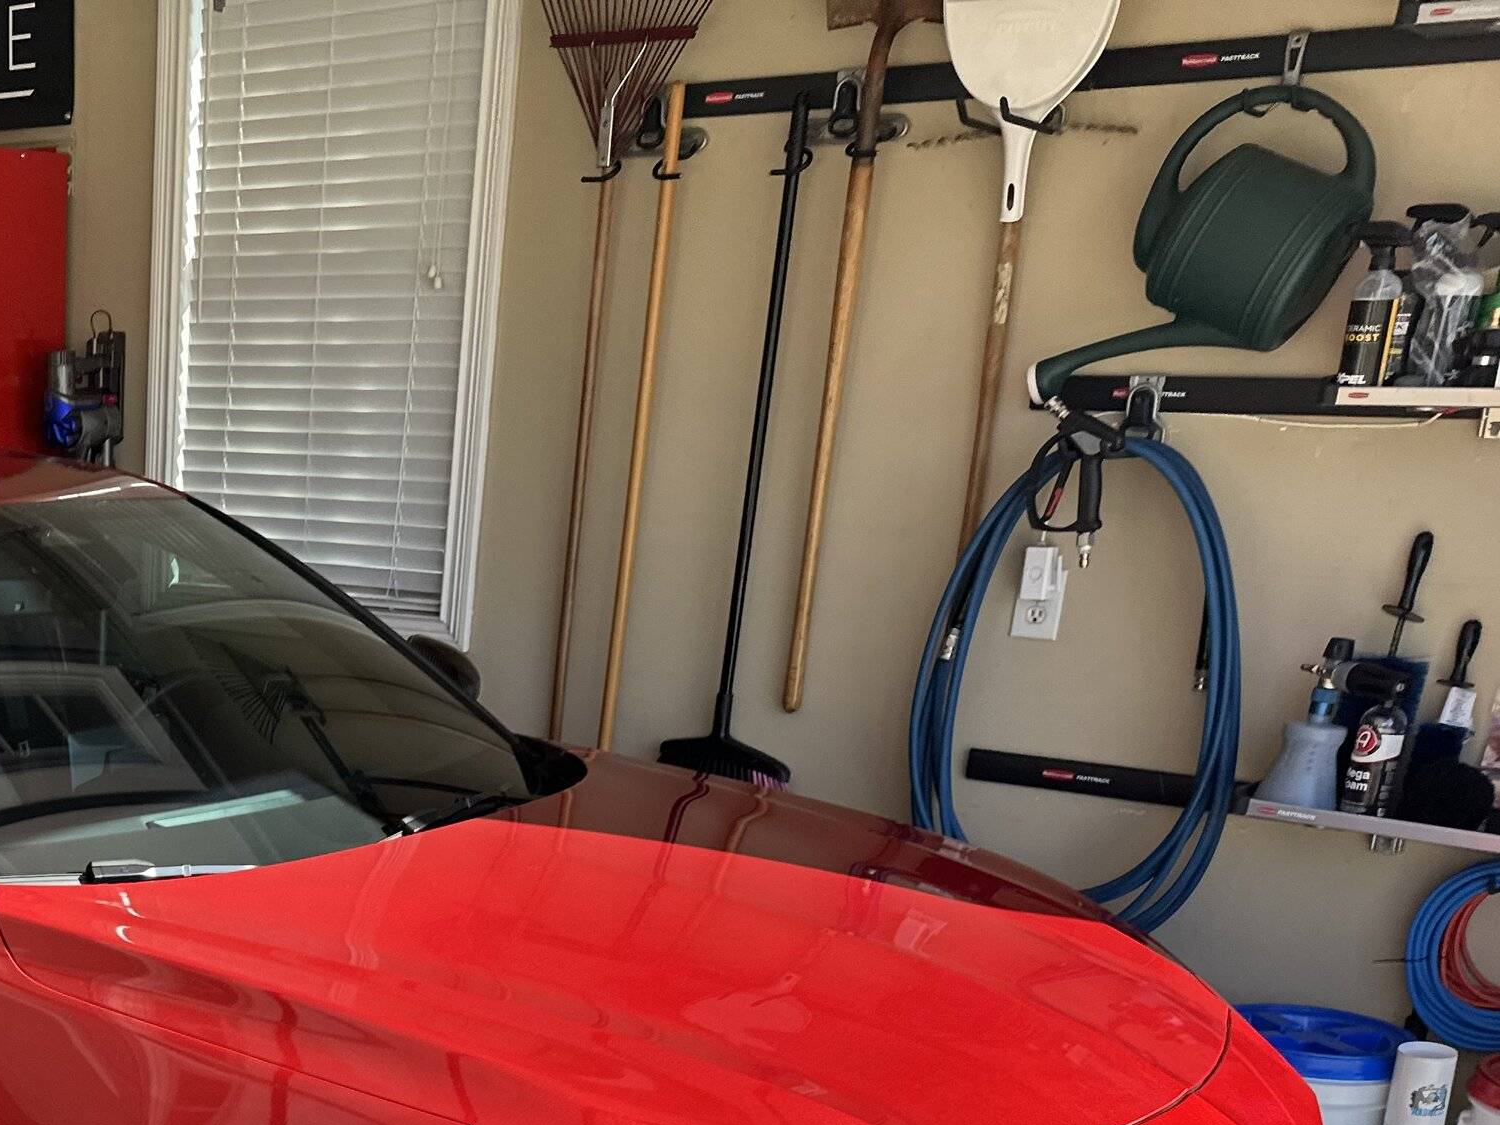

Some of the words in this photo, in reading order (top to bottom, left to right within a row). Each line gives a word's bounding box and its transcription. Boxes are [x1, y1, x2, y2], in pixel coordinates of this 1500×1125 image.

[1348, 324, 1380, 333] ERAMIC
[1347, 333, 1380, 342] OOST
[1347, 767, 1371, 782] ega
